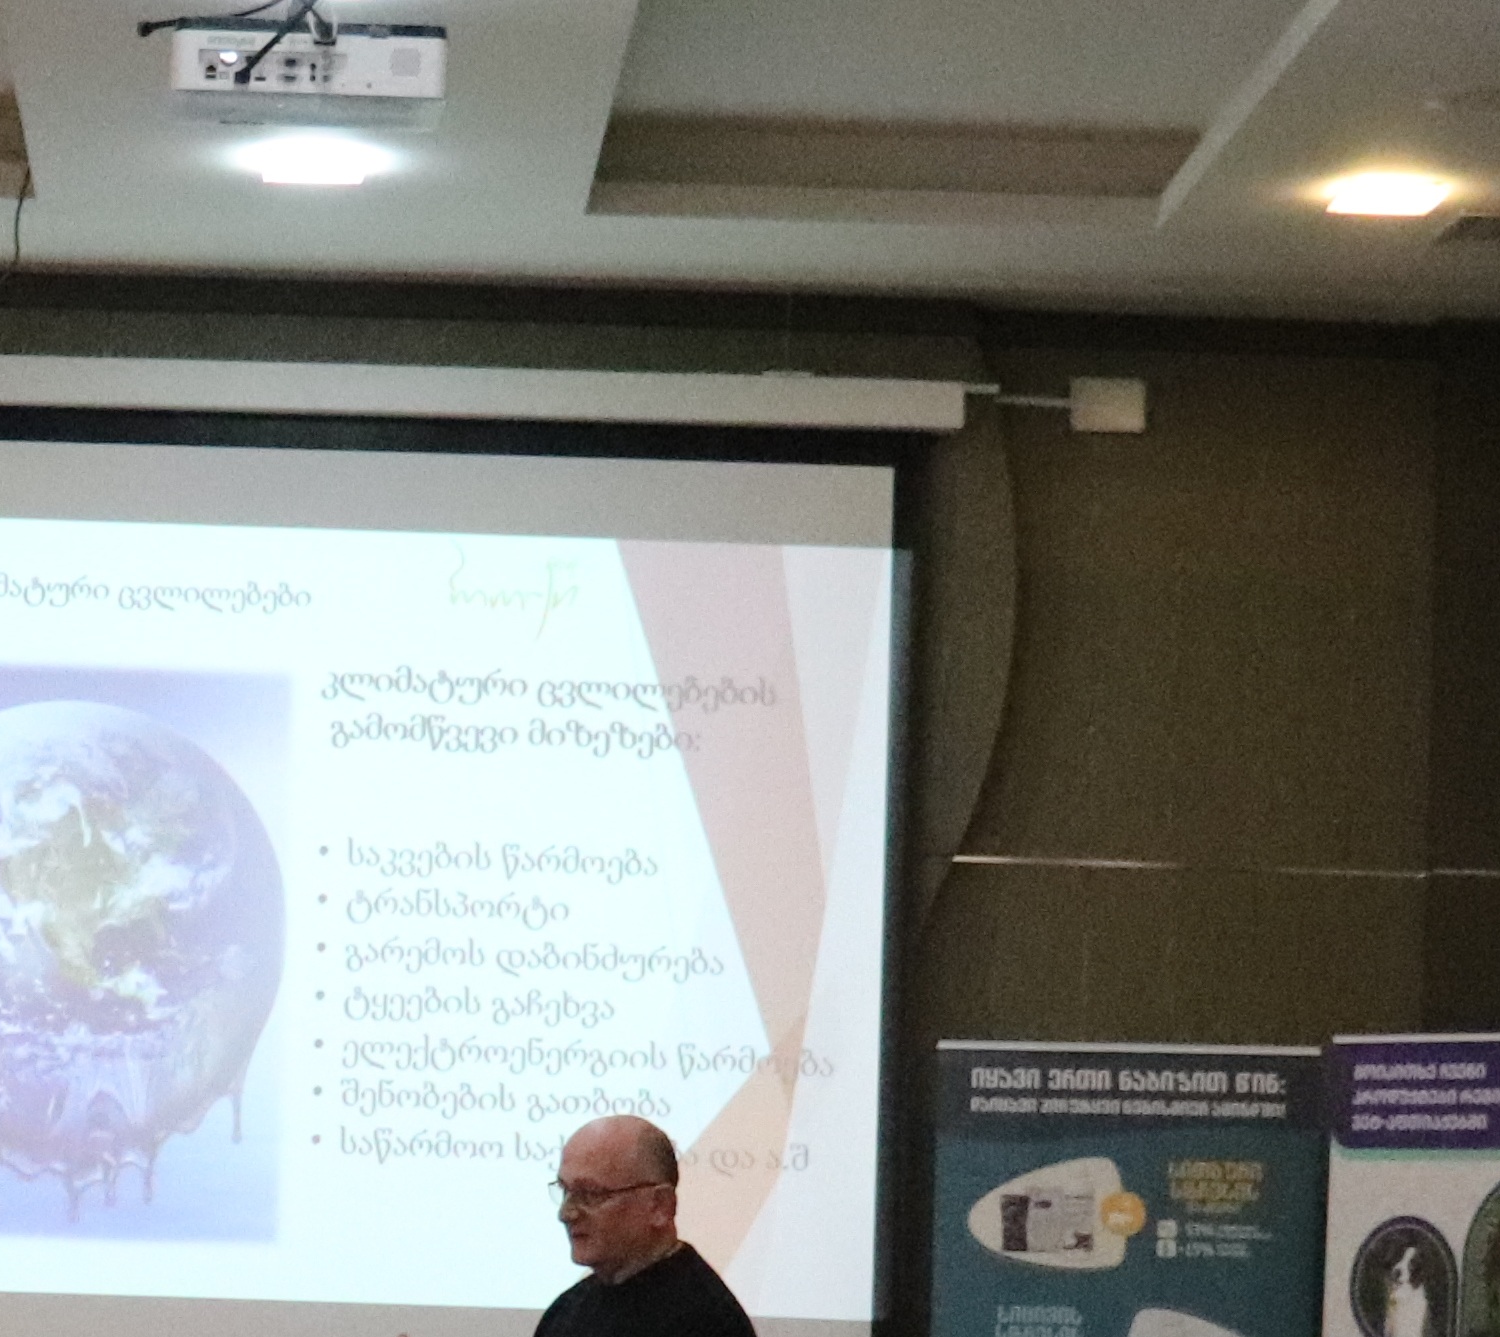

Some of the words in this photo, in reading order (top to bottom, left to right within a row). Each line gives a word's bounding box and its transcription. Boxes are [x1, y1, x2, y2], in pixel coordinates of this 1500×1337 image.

[117, 578, 312, 615] ცვლილებები
[320, 666, 528, 704] კლიმატური
[537, 673, 777, 714] ცვლილებების
[330, 713, 519, 753] გამომწვევი
[527, 719, 701, 759] მიზეზები:
[347, 836, 492, 878] საკვების
[502, 843, 659, 885] წარმოება
[346, 888, 570, 931] ტრანსპორტი
[345, 936, 486, 974] გარემოს
[496, 943, 725, 981] დაბინძურება
[343, 986, 482, 1022] ტყეების
[491, 990, 616, 1028] გაჩეხვა
[342, 1034, 667, 1076] ელექტროენერგიის
[341, 1078, 516, 1112] შენობების
[527, 1085, 672, 1122] გათბობა
[970, 1066, 1041, 1090] იყავი
[1047, 1067, 1112, 1091] ერთი
[340, 1125, 505, 1165] საწარმოო
[710, 1149, 755, 1178] და
